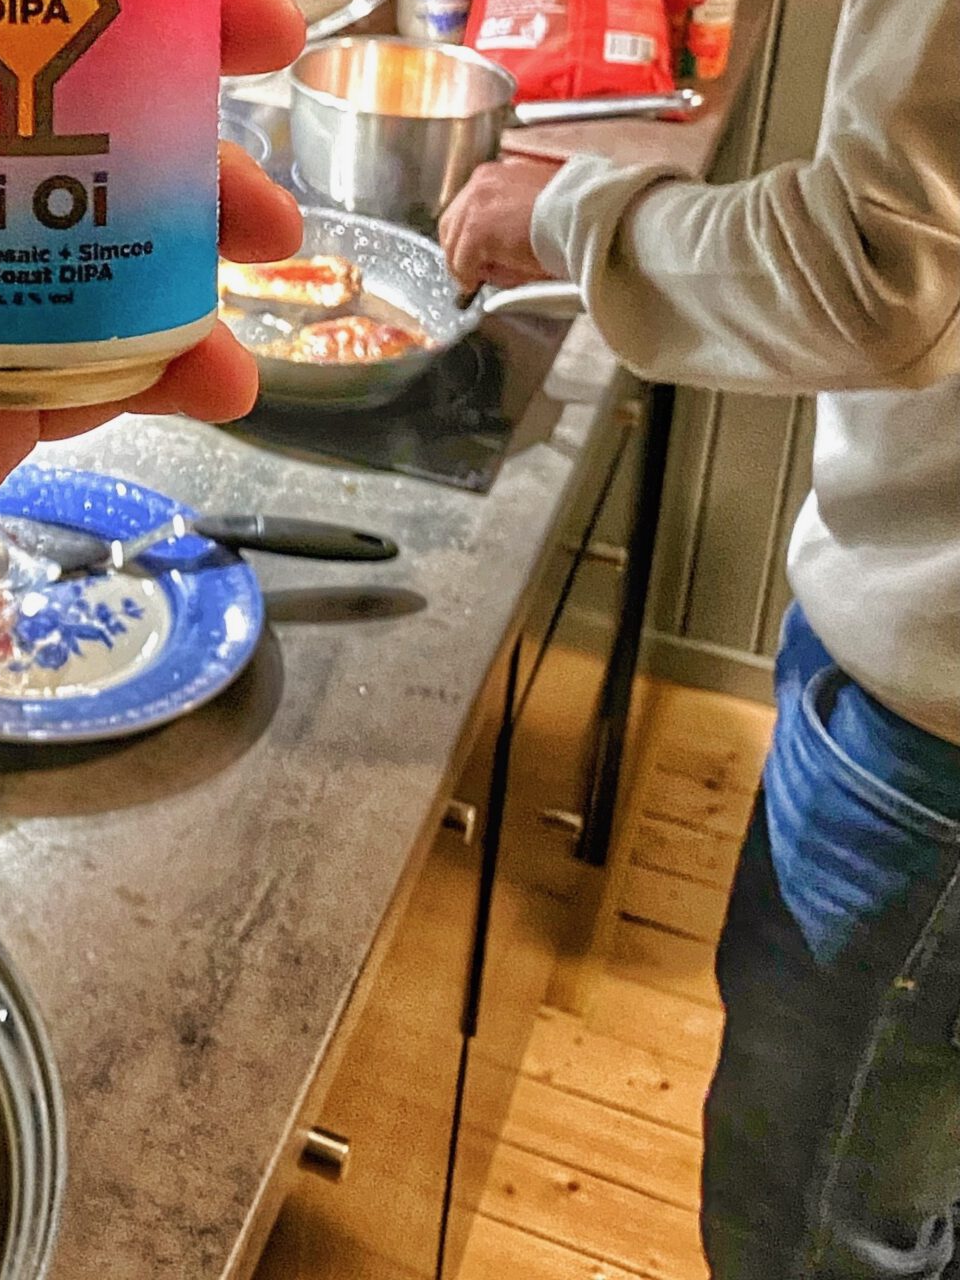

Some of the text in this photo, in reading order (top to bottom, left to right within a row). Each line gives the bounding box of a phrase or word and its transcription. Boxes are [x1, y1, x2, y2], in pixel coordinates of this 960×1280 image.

[32, 172, 108, 229] Oi
[78, 239, 154, 262] Simcoe
[58, 262, 113, 283] DIPA
